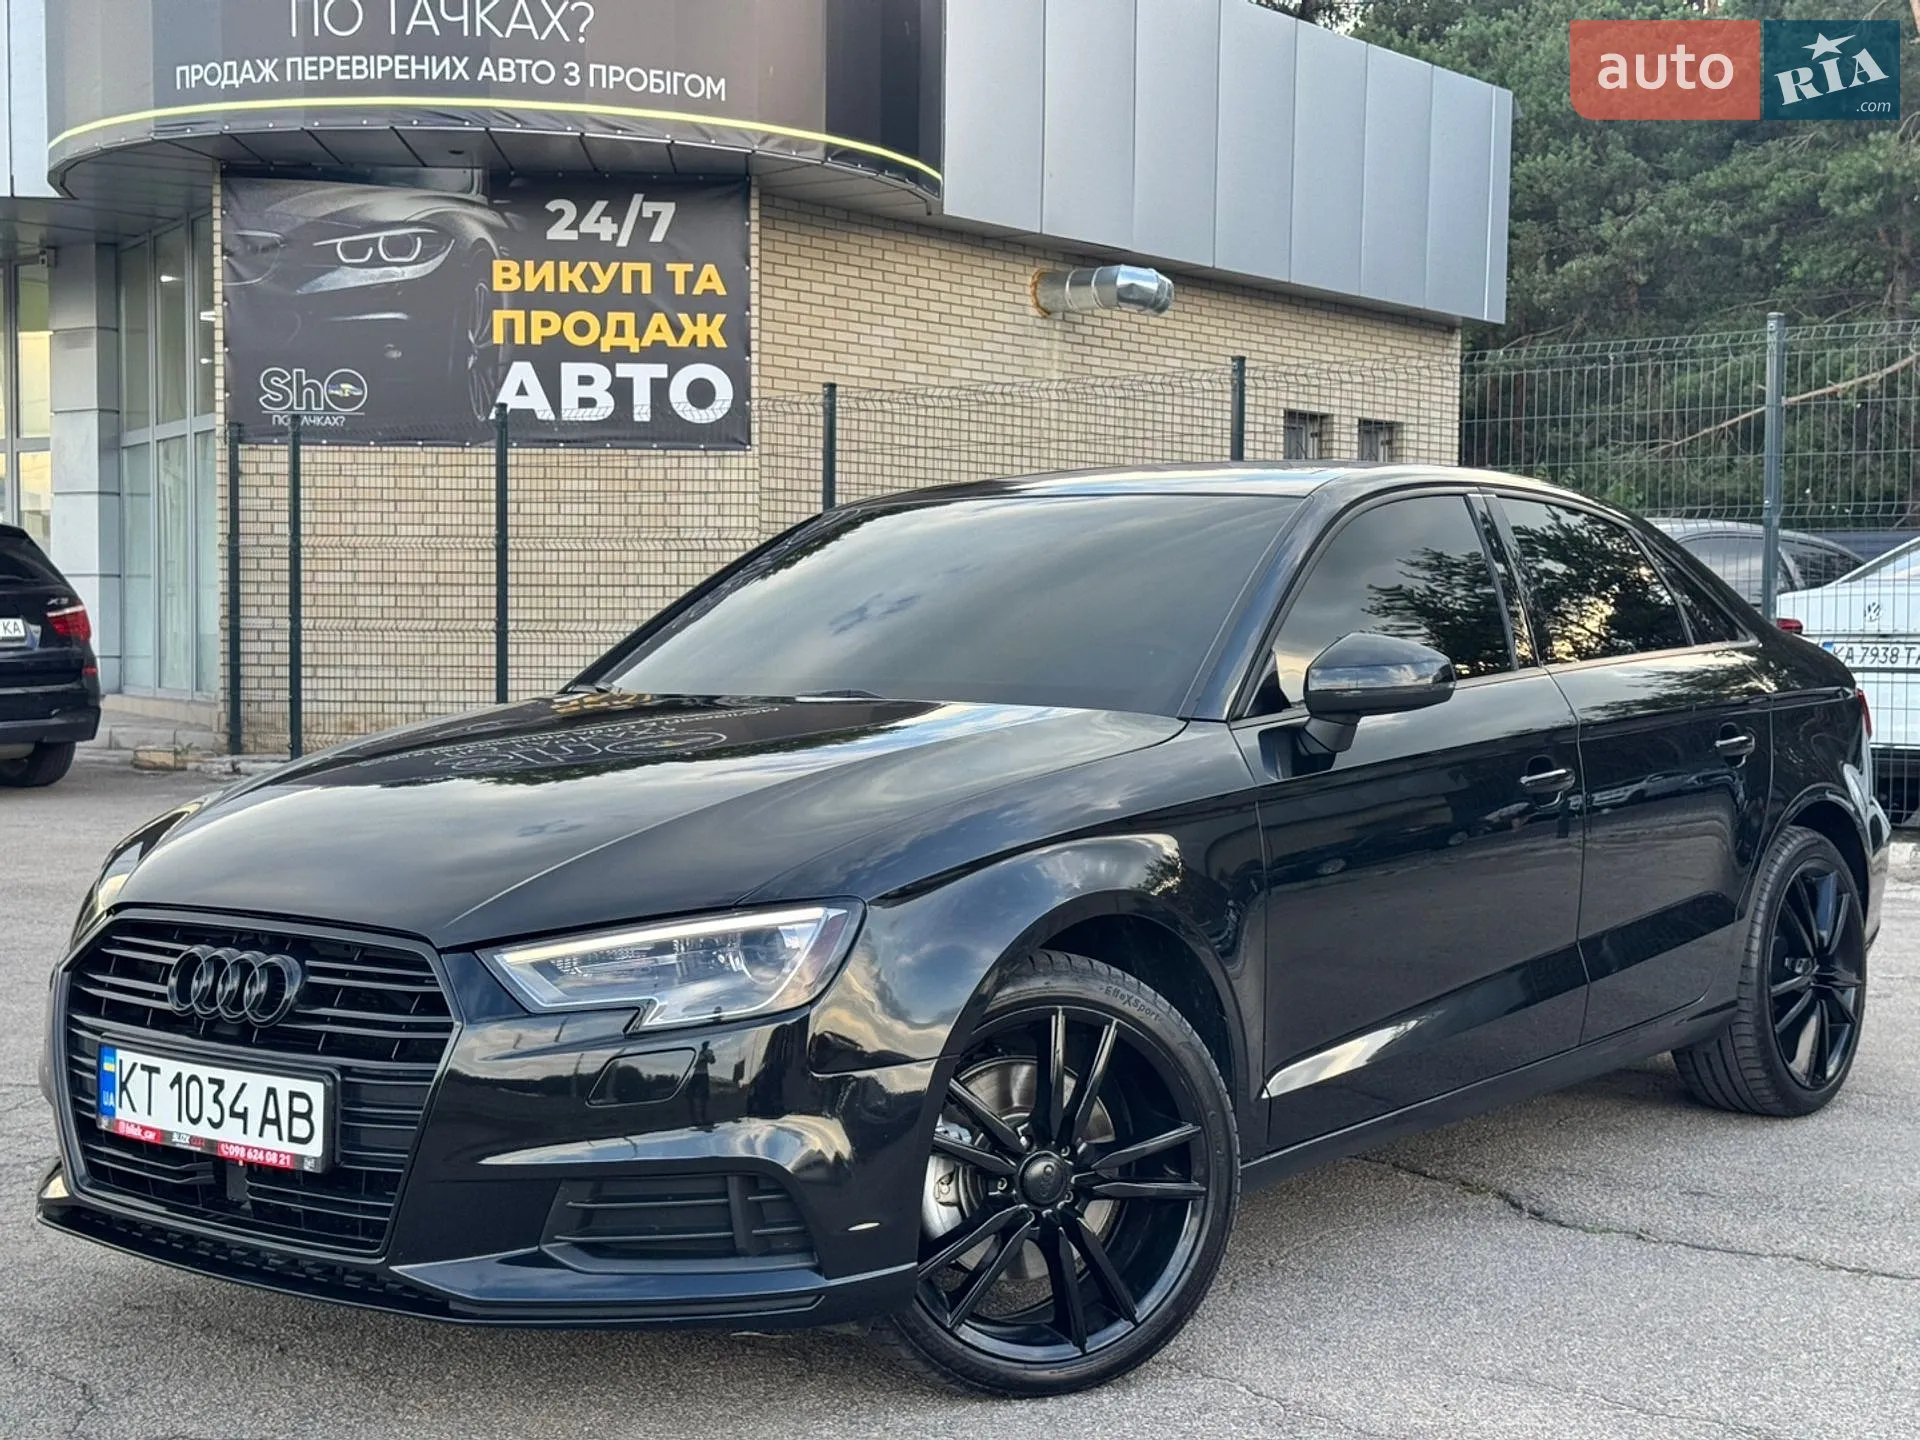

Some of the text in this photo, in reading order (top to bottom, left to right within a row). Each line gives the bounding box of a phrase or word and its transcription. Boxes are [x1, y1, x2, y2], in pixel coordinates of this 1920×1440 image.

[175, 57, 280, 90] ПРОДАЖ
[286, 54, 470, 82] ПЕРЕВІРЕНИХ
[476, 56, 556, 86] АВТО
[588, 63, 727, 102] ПРОБІГОМ
[544, 193, 677, 247] 24/7
[492, 259, 728, 296] ВИКУП ТА
[492, 309, 729, 354] ПРОДАЖ
[488, 361, 735, 424] АВТО
[300, 415, 347, 427] АЧКАХ?
[2, 620, 22, 636] KA
[1859, 646, 1900, 665] 7938
[102, 1089, 116, 1108] UA
[118, 1058, 316, 1146] KT 1034 AB
[229, 1144, 246, 1158] 098
[246, 1147, 264, 1161] 624
[265, 1151, 278, 1164] 08
[279, 1154, 291, 1167] 21
